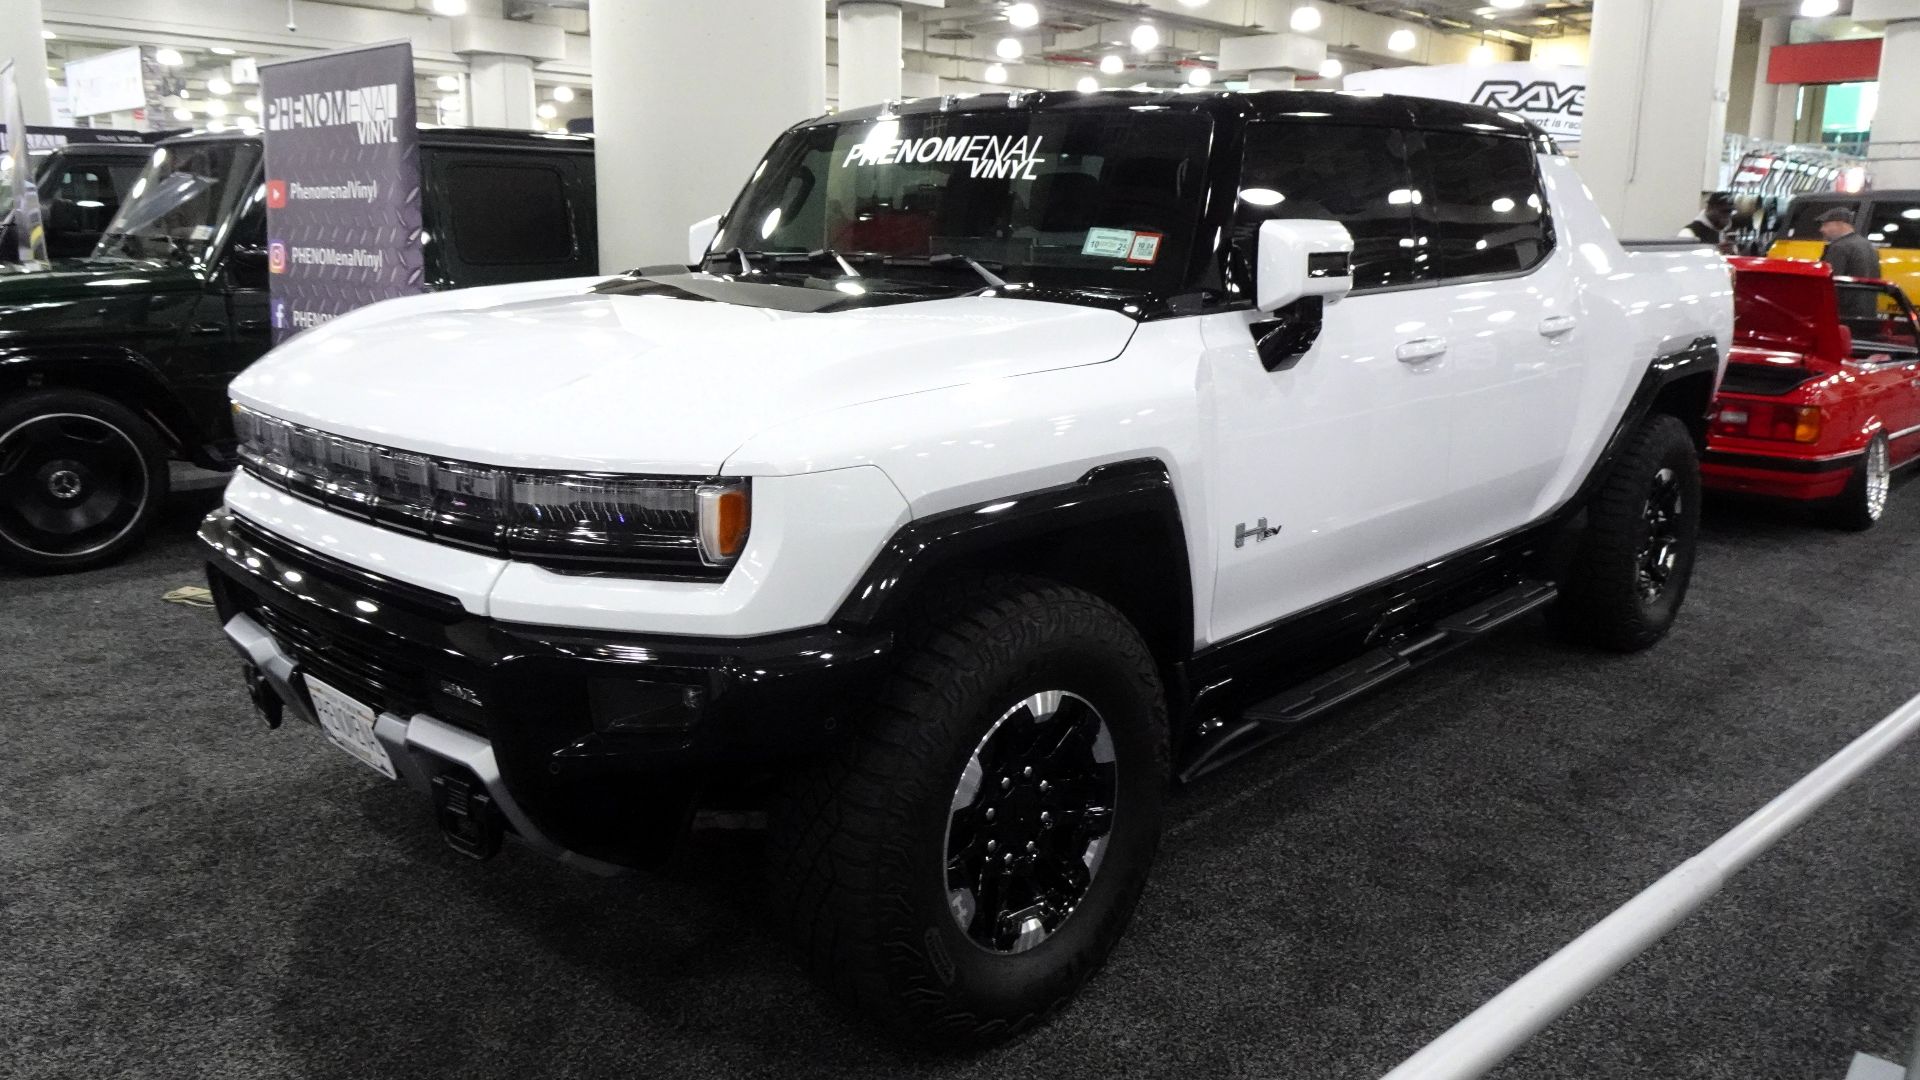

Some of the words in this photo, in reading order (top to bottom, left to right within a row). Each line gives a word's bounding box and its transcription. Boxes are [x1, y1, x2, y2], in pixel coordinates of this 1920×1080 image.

[268, 84, 398, 131] PHENOMENAL
[356, 118, 399, 145] VINYL
[842, 135, 1045, 168] PHENOMENAL
[970, 158, 1037, 180] VINYL
